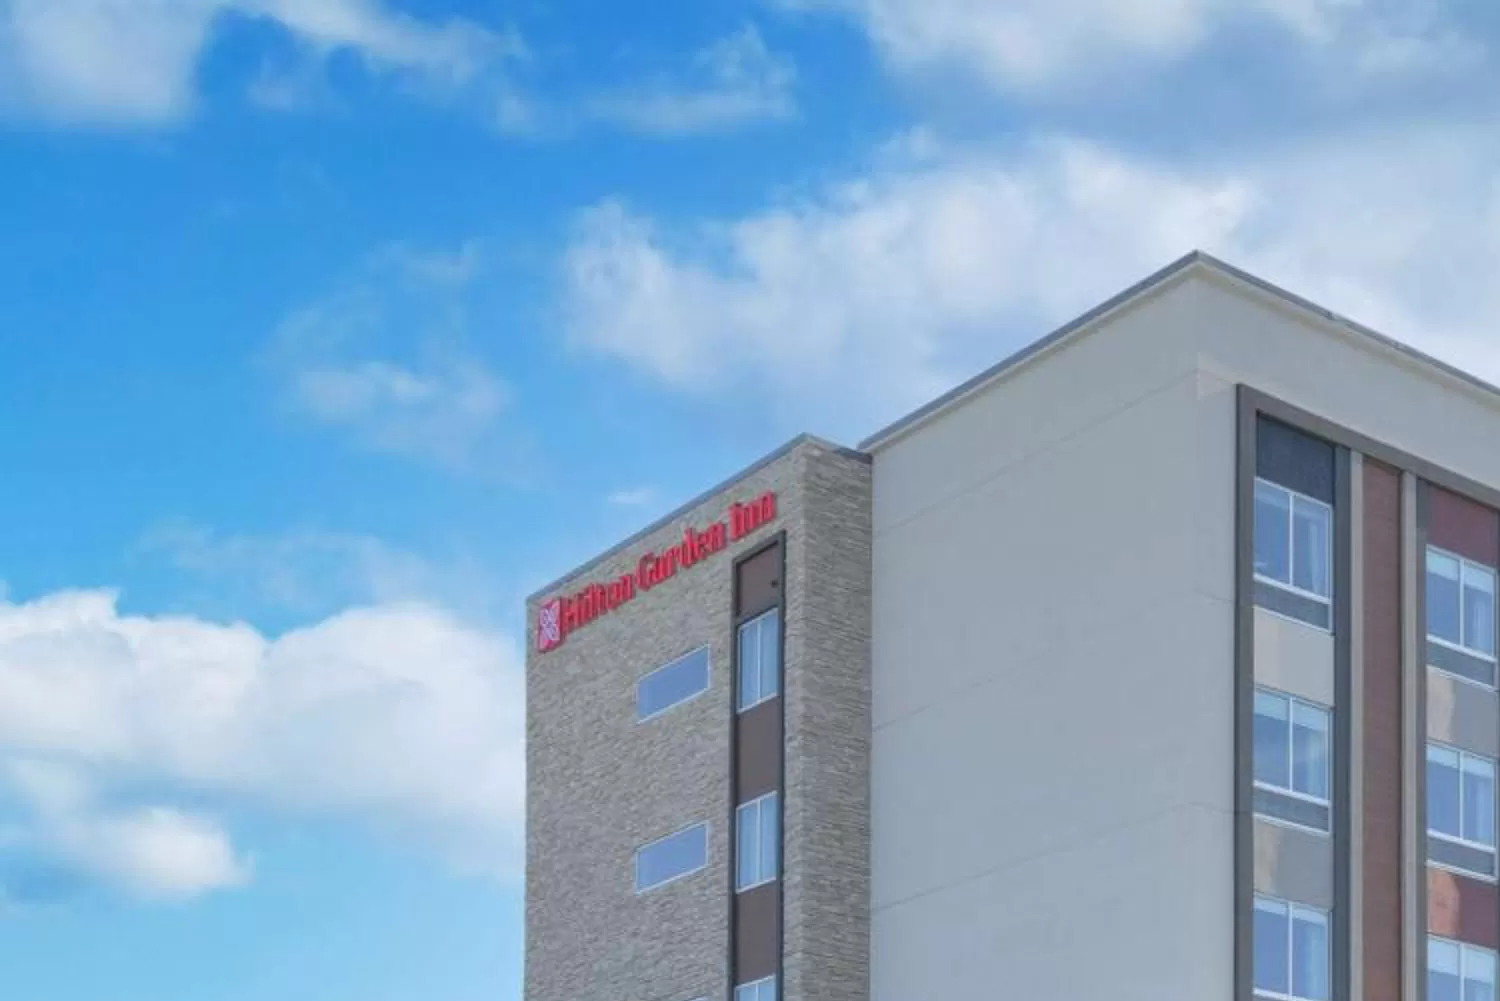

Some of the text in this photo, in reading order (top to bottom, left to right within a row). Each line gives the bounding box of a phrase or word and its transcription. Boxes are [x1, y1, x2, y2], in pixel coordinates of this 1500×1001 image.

[560, 490, 775, 635] Hilton Garden Inn
